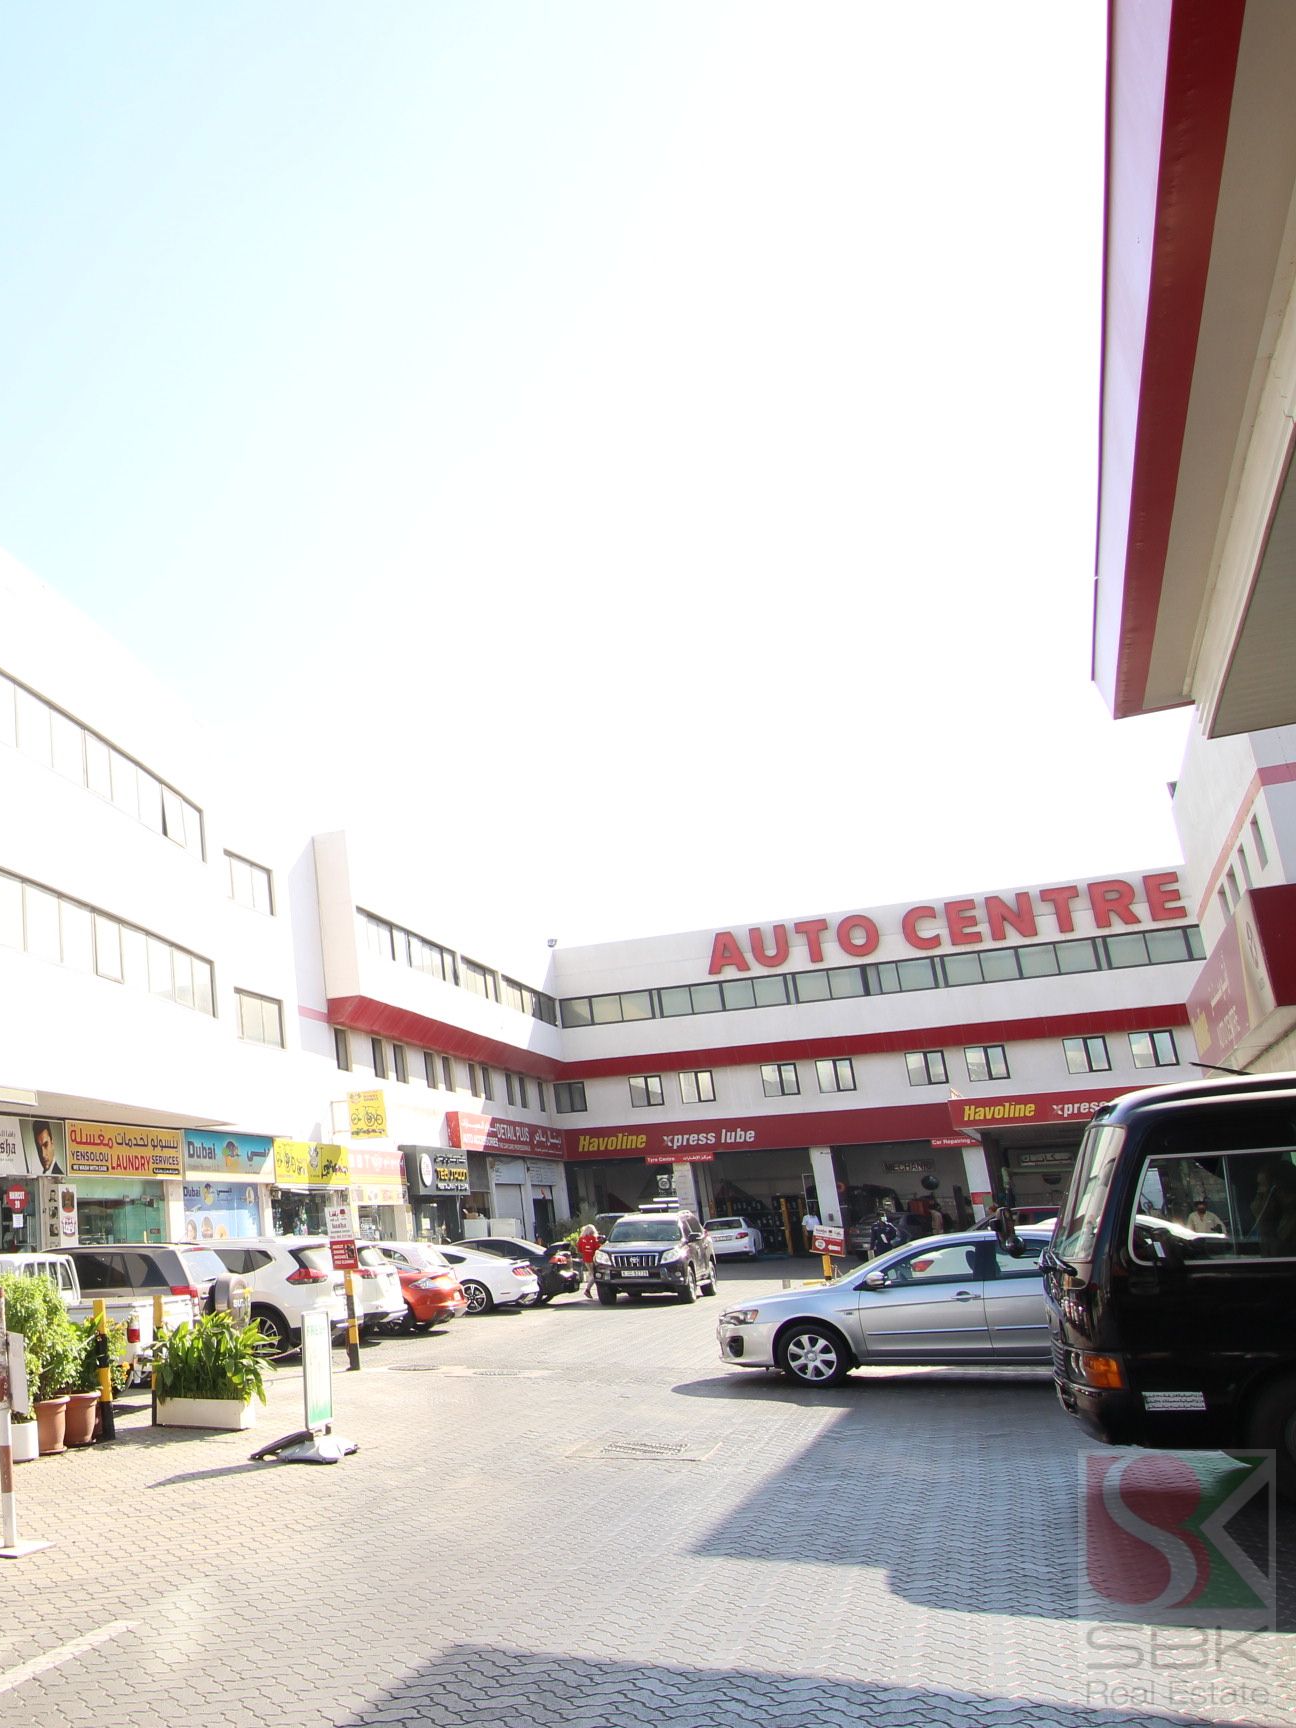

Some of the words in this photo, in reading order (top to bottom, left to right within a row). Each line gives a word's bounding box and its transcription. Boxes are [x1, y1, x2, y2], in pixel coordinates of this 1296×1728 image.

[707, 914, 881, 975] AUTO
[900, 871, 1188, 951] CENTRE
[964, 1102, 1036, 1121] Havoline
[70, 1123, 114, 1149] مغسلة
[496, 1123, 516, 1140] DETAIL
[515, 1126, 530, 1142] PLUS
[578, 1132, 647, 1152] Havoline
[663, 1130, 716, 1149] xpress
[721, 1127, 756, 1144] lube
[187, 1140, 216, 1160] Dubai
[71, 1150, 109, 1162] YENSOLOU
[110, 1154, 151, 1171] LAUNDRY
[151, 1154, 179, 1165] SERVICES
[183, 1185, 201, 1197] Dubai
